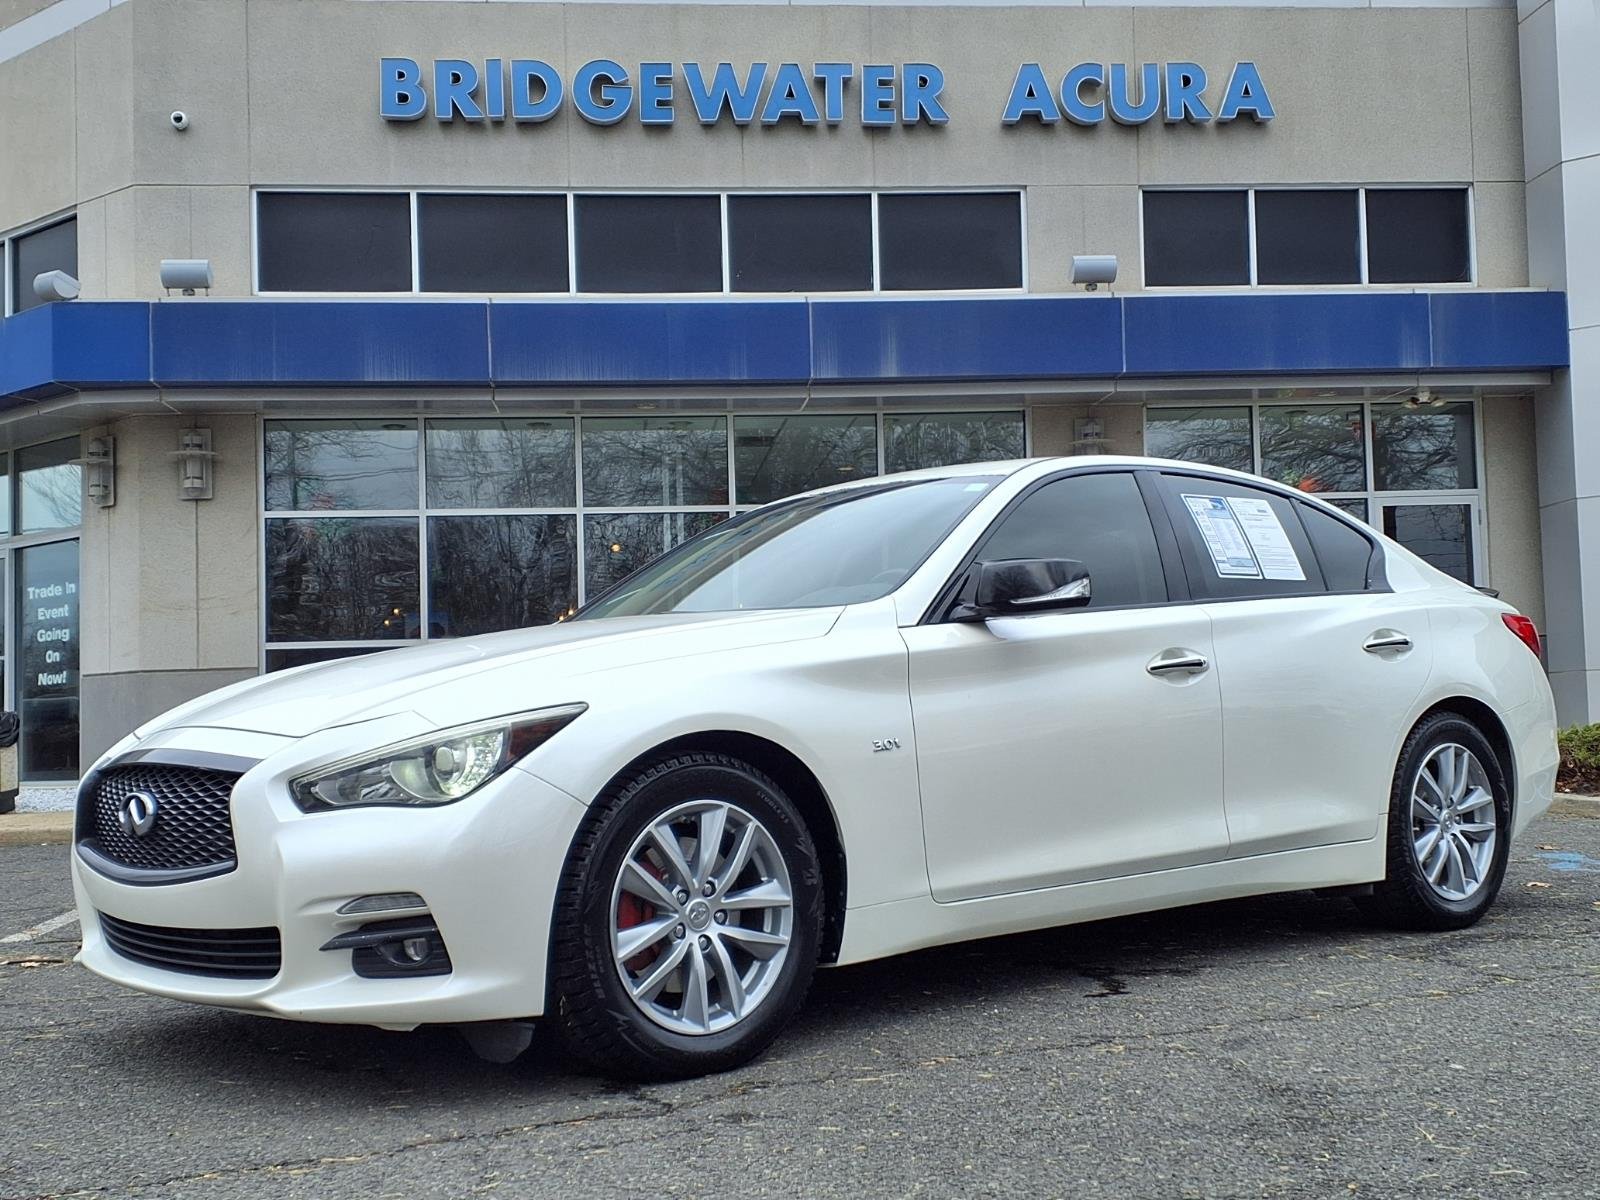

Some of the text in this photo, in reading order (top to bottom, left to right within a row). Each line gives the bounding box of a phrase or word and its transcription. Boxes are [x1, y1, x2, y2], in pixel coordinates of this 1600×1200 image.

[379, 57, 1276, 126] BRIDGEWATER ACURA
[27, 582, 76, 599] Trade In
[37, 604, 69, 620] Event
[37, 628, 70, 641] Going
[45, 650, 60, 663] On
[38, 671, 67, 686] Now!
